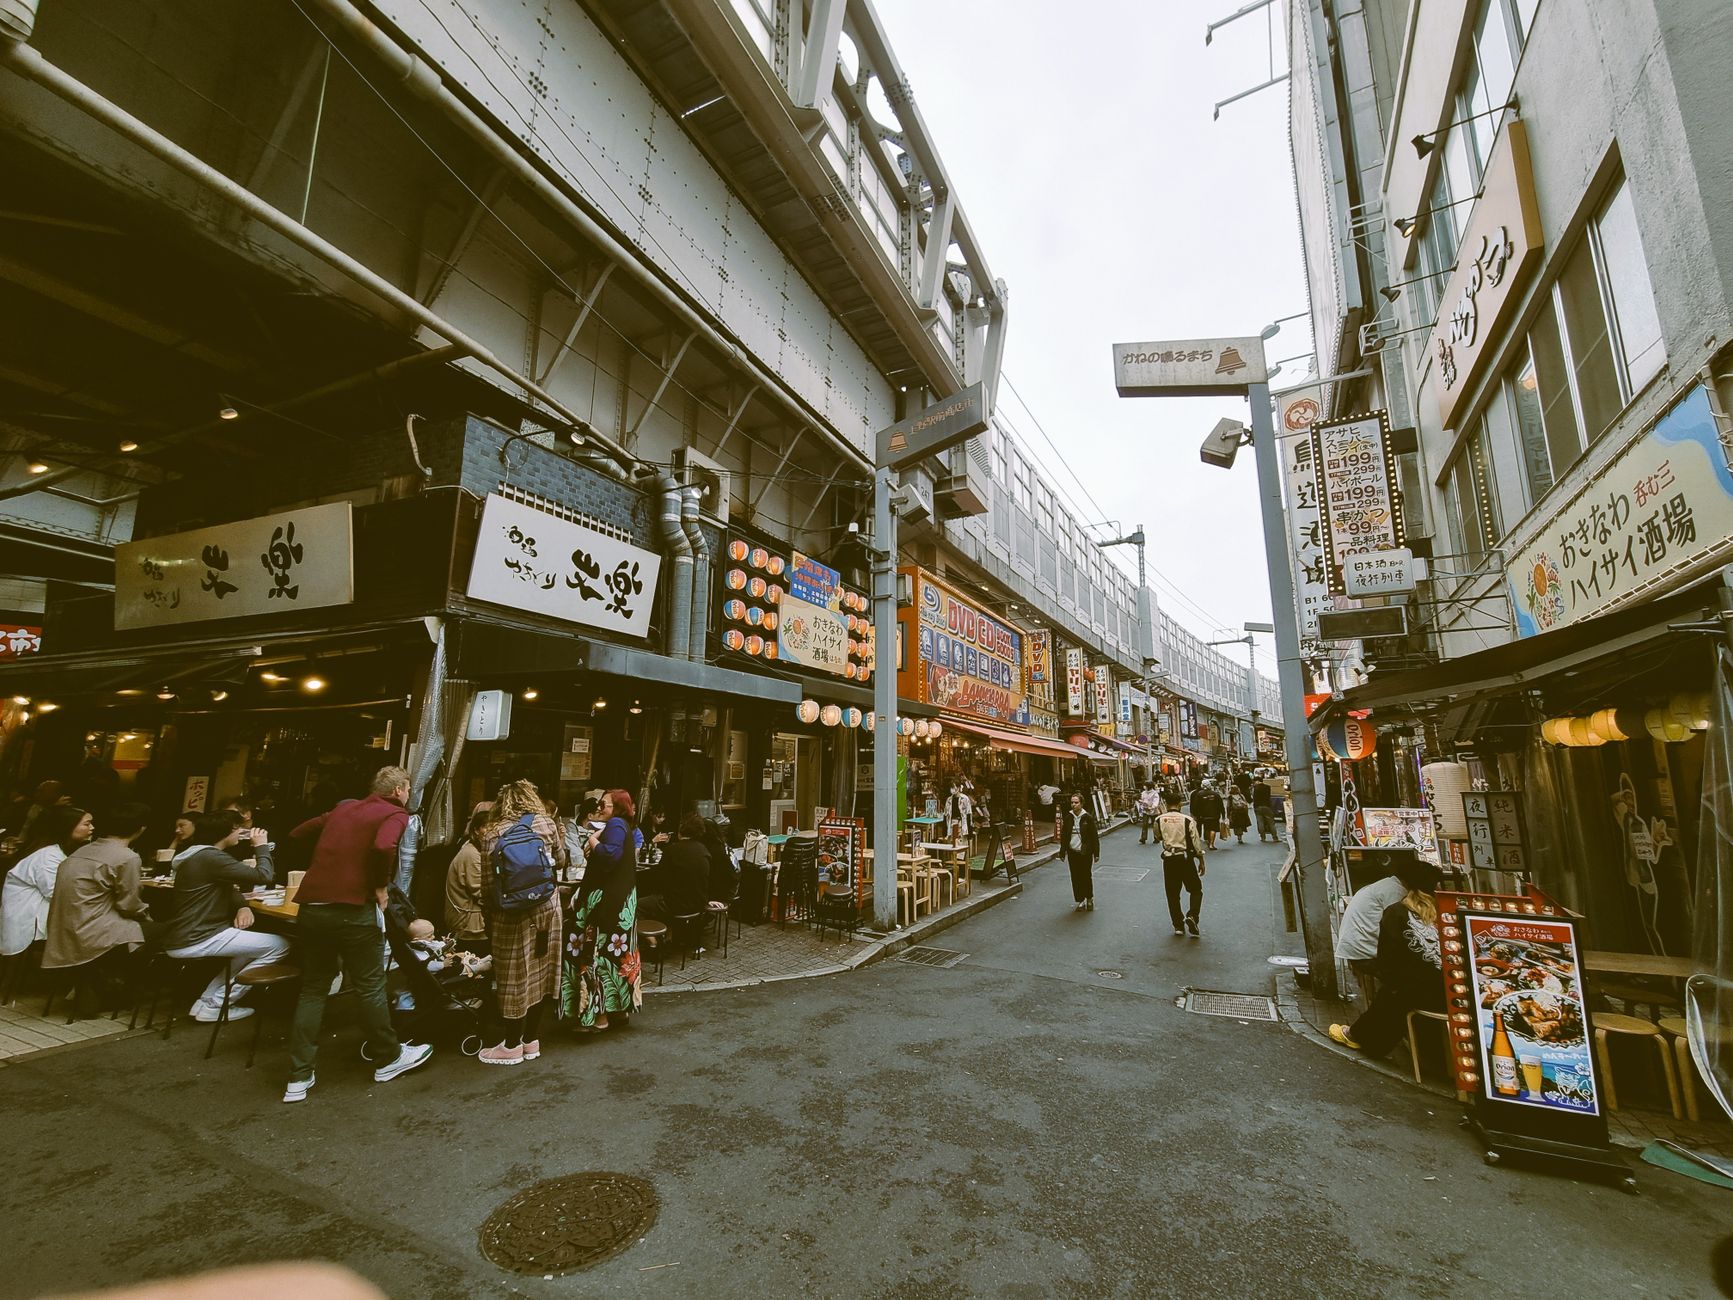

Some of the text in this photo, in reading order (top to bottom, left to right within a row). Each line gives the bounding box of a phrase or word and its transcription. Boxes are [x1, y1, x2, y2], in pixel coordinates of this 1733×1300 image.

[1122, 350, 1213, 365] かねの鳴るまち
[1324, 426, 1360, 440] アサヒ
[1326, 434, 1374, 449] スーパー
[1331, 474, 1382, 489] ハイボール
[1337, 507, 1385, 523] 串かつ
[1559, 492, 1630, 568] おきなわ
[1337, 532, 1391, 547] 一品料理
[1571, 492, 1696, 610] ハイサイ酒場
[1355, 559, 1387, 571] 日本酒
[1355, 570, 1404, 587] 夜行列車
[812, 615, 843, 636] おきなわ
[948, 597, 995, 651] DVD CD
[812, 633, 843, 651] ハイサイ
[812, 646, 829, 664] 酒場
[1347, 724, 1361, 751] Orion
[1496, 1063, 1515, 1072] Orion
